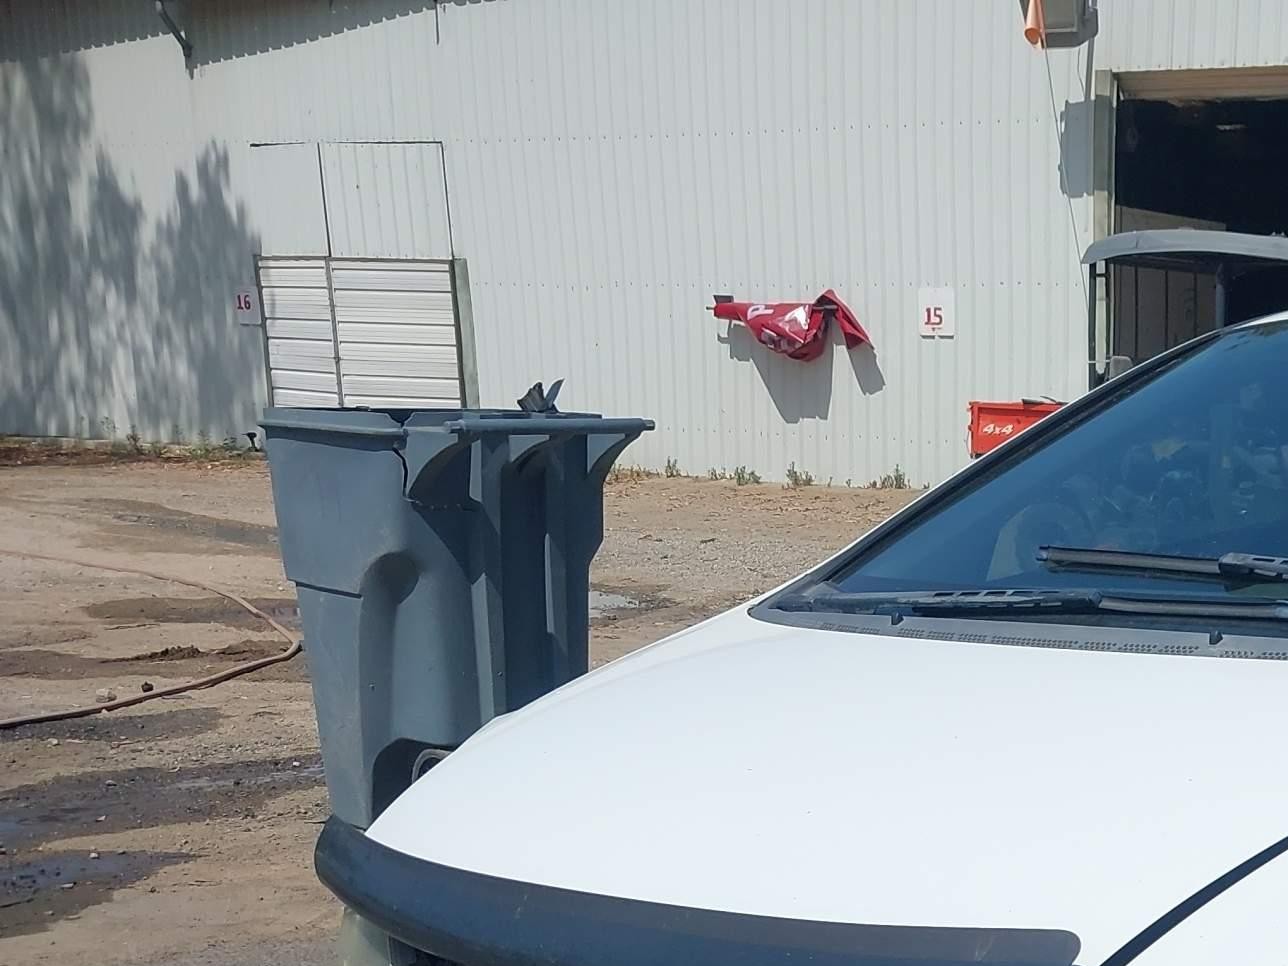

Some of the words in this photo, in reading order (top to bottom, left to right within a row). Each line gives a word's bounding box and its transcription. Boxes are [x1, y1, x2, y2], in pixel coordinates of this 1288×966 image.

[237, 294, 251, 310] 16
[924, 307, 943, 326] 15
[983, 423, 1014, 436] 4x4
